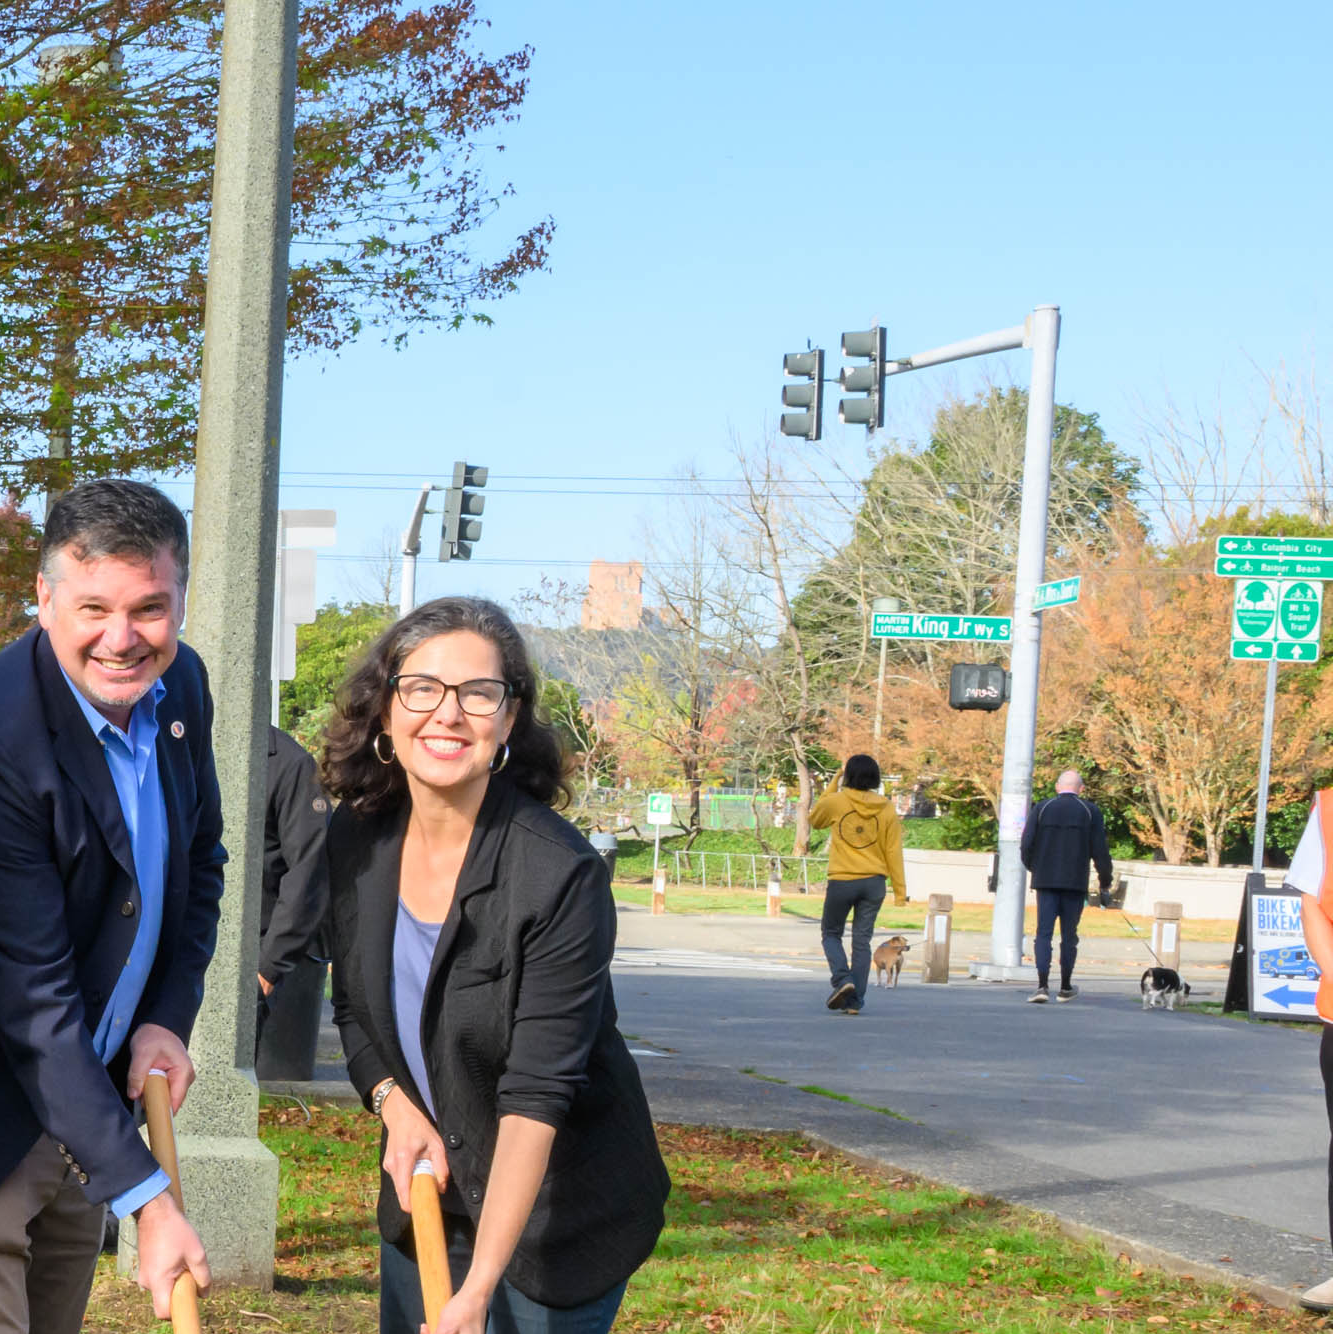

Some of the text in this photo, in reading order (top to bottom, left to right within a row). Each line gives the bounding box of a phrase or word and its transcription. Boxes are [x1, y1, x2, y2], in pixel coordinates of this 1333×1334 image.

[1262, 543, 1322, 554] Columbia City
[1296, 564, 1321, 573] Beach
[876, 616, 910, 625] MARTIN
[875, 625, 909, 634] LUTHER
[912, 615, 1008, 639] King Jr Wy S
[1291, 622, 1307, 631] Trail
[1258, 898, 1286, 914] BIKE
